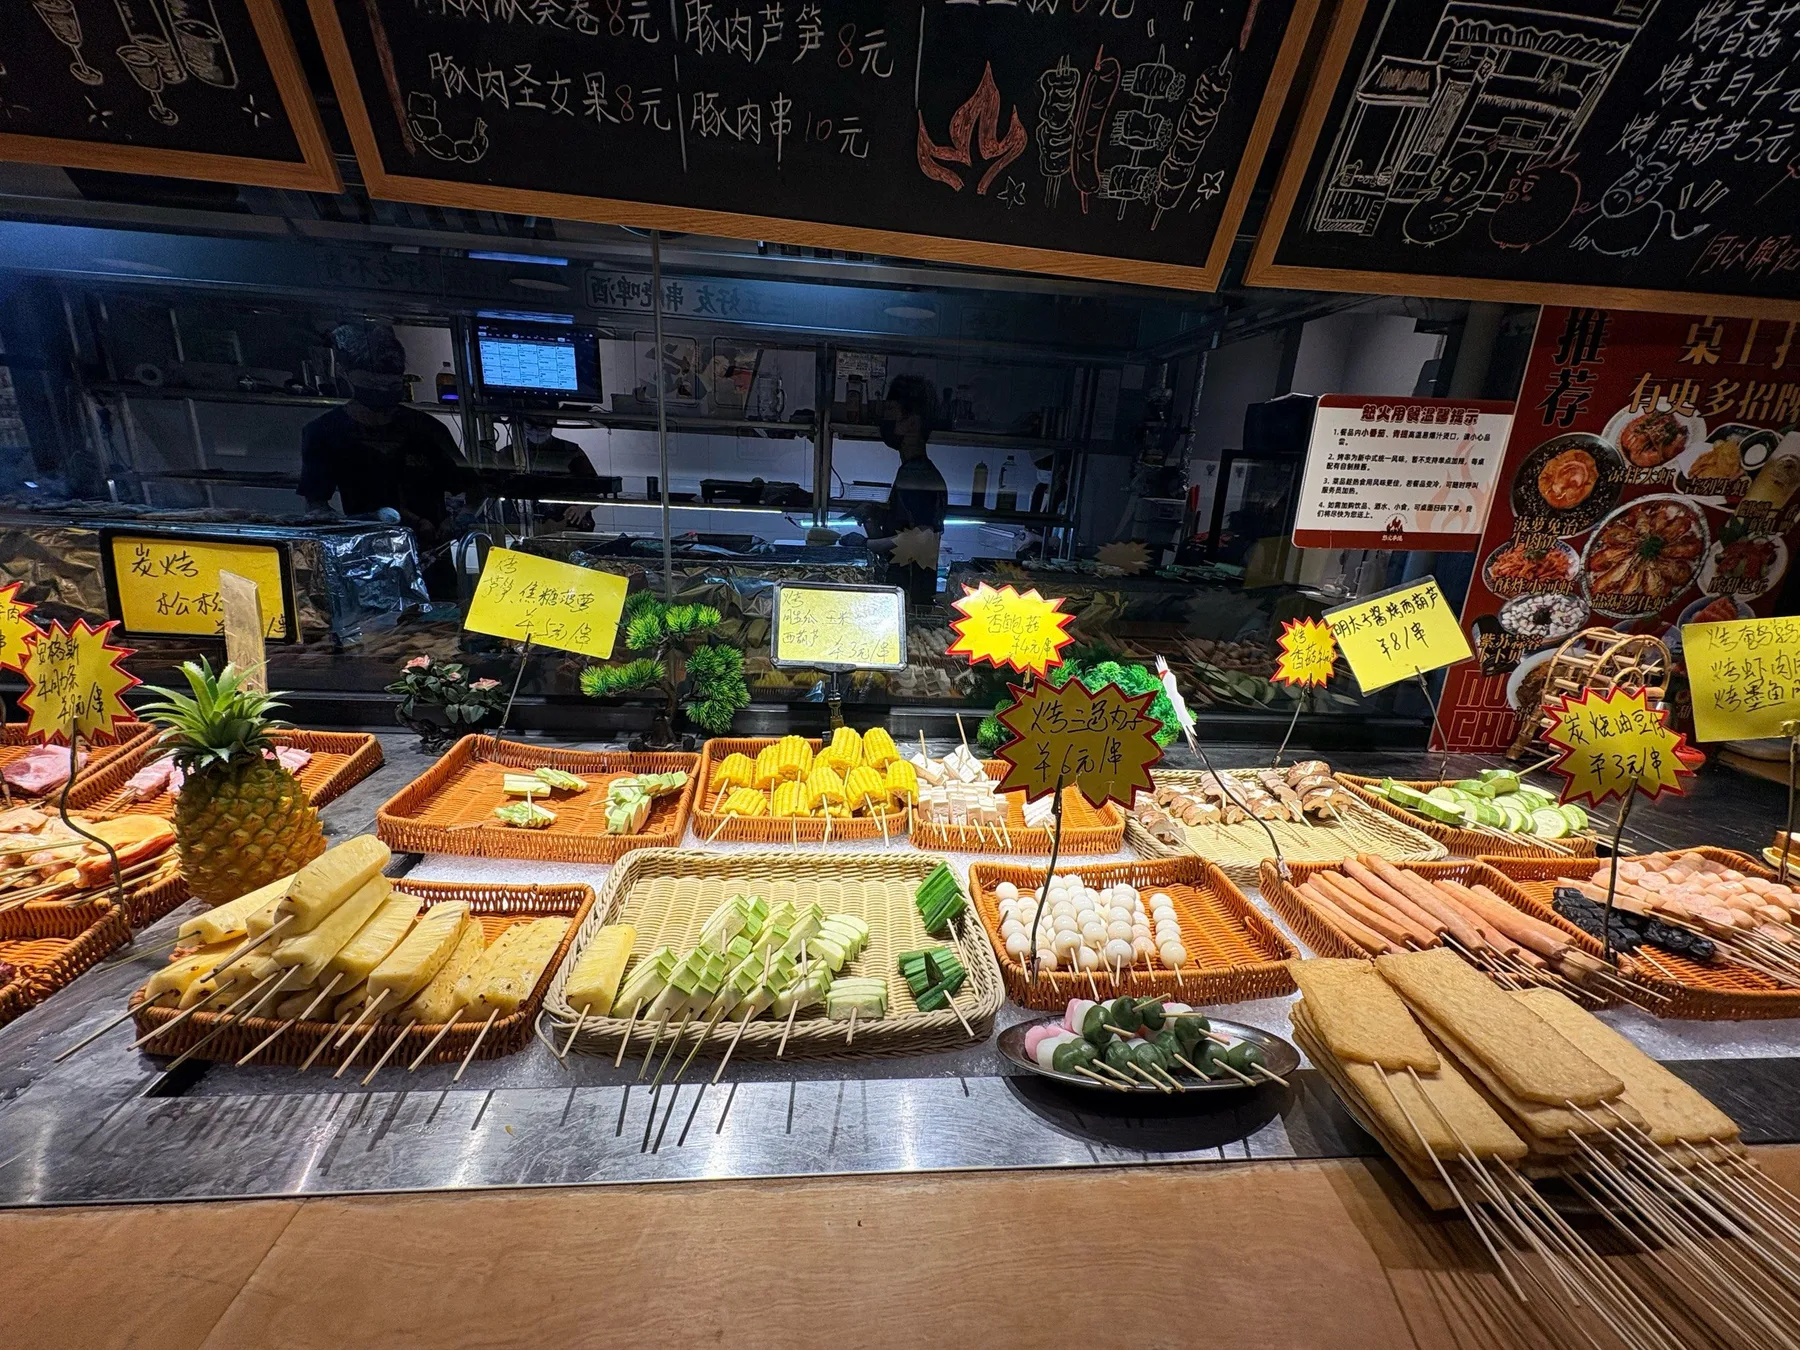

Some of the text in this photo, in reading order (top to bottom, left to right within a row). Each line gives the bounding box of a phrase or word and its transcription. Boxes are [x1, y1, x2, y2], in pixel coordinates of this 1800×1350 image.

[132, 543, 199, 578] 炭烤
[1334, 586, 1439, 638] 明太子酱烤西葫芦
